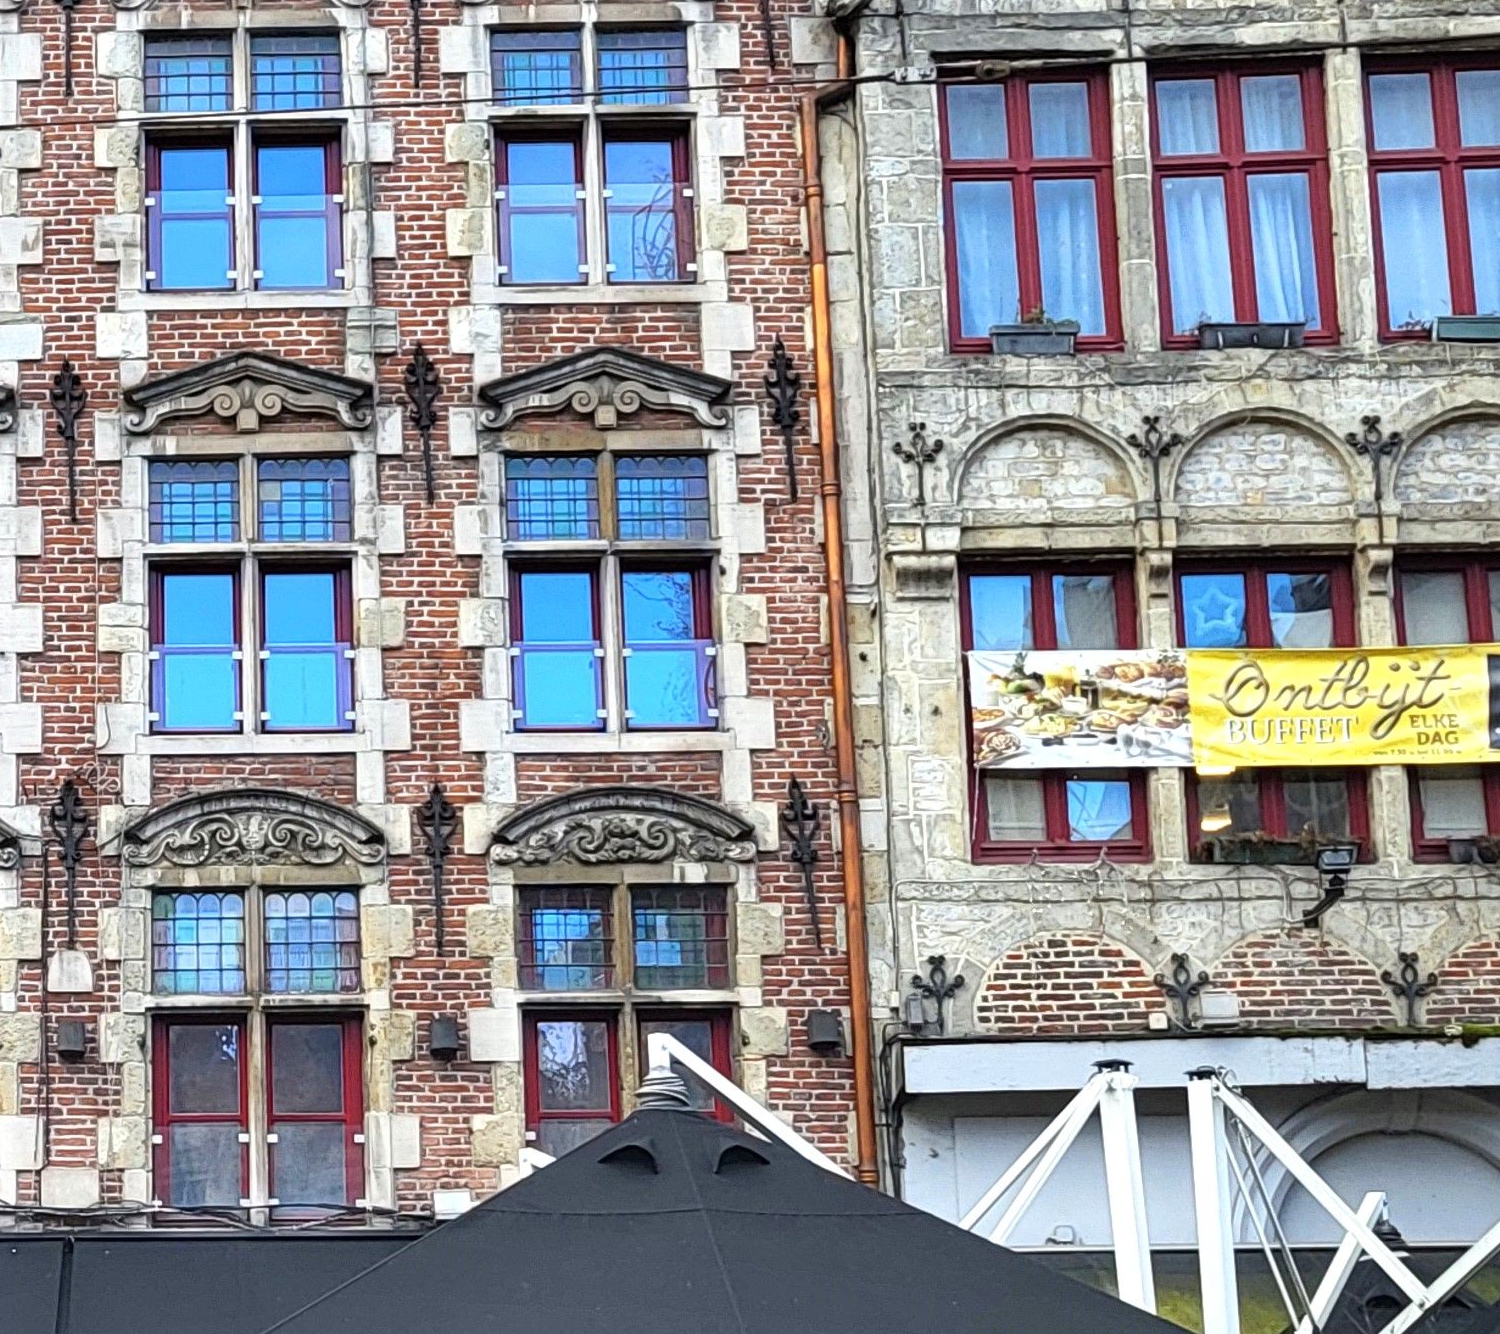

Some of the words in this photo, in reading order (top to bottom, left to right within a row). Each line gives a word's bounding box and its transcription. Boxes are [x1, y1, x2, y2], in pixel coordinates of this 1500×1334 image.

[1409, 714, 1460, 729] ELKE
[1226, 717, 1360, 745] BUFFET
[1417, 731, 1460, 746] DAG
